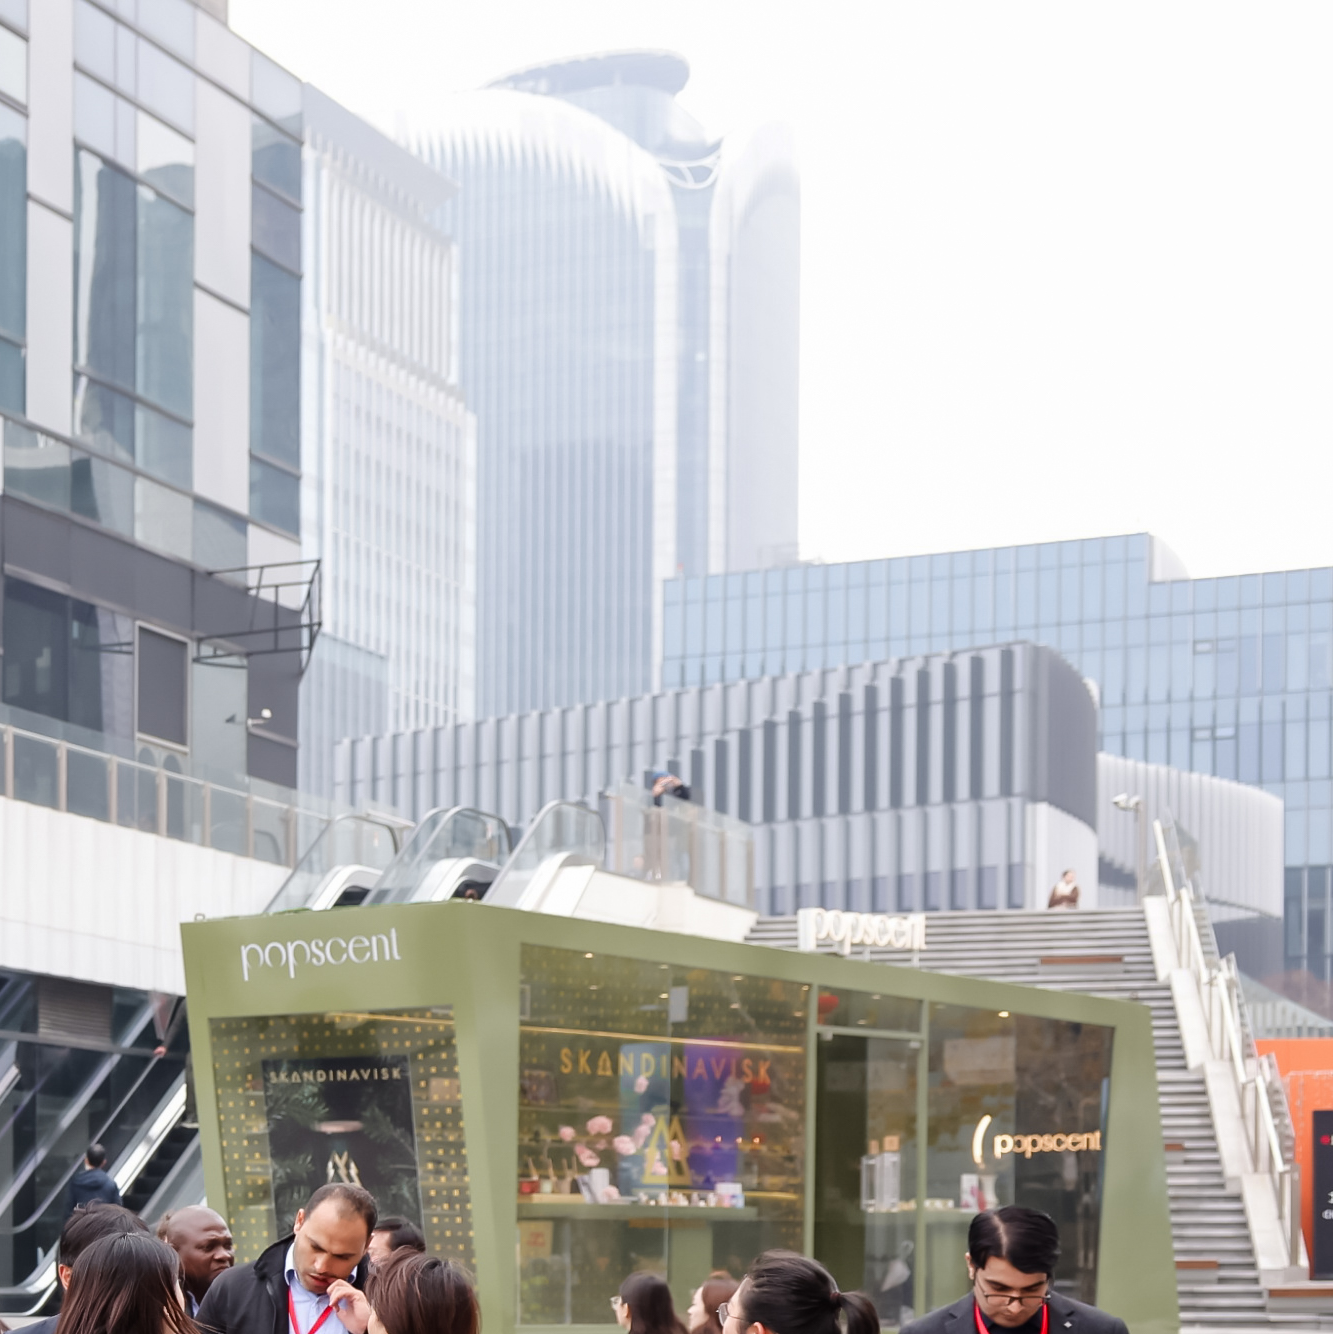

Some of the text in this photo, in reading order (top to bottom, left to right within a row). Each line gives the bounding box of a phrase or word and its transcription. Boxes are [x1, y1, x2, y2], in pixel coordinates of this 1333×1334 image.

[240, 927, 401, 982] popscent
[269, 1067, 402, 1084] SKANDINAVISK
[560, 1047, 771, 1084] SKANDINAVISK
[993, 1129, 1101, 1159] popscent
